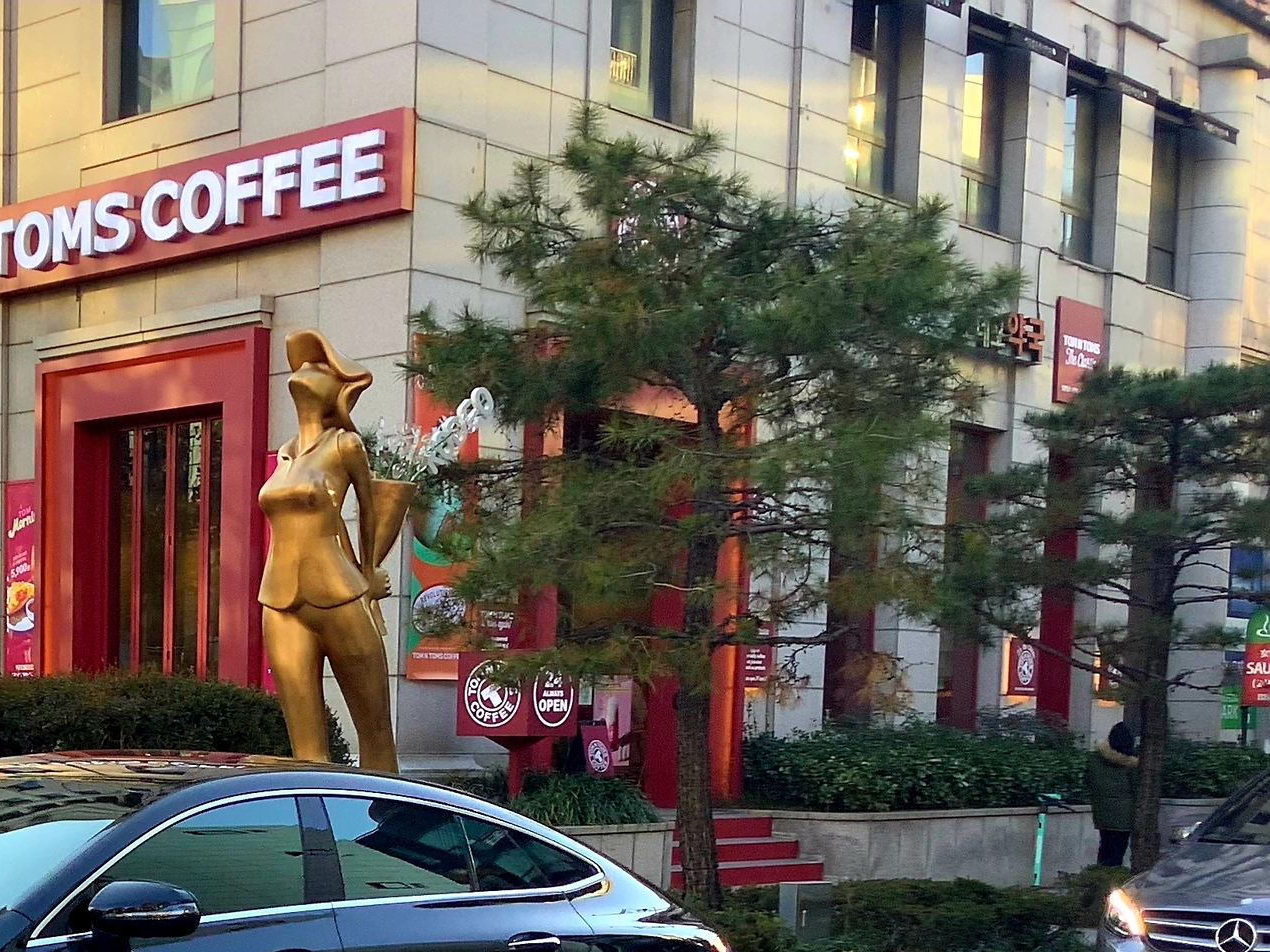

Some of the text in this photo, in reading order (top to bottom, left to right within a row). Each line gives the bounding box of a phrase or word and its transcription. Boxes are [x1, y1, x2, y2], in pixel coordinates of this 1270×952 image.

[141, 128, 386, 242] COFFEE
[470, 701, 514, 723] COFFEE
[538, 699, 568, 712] OPEN
